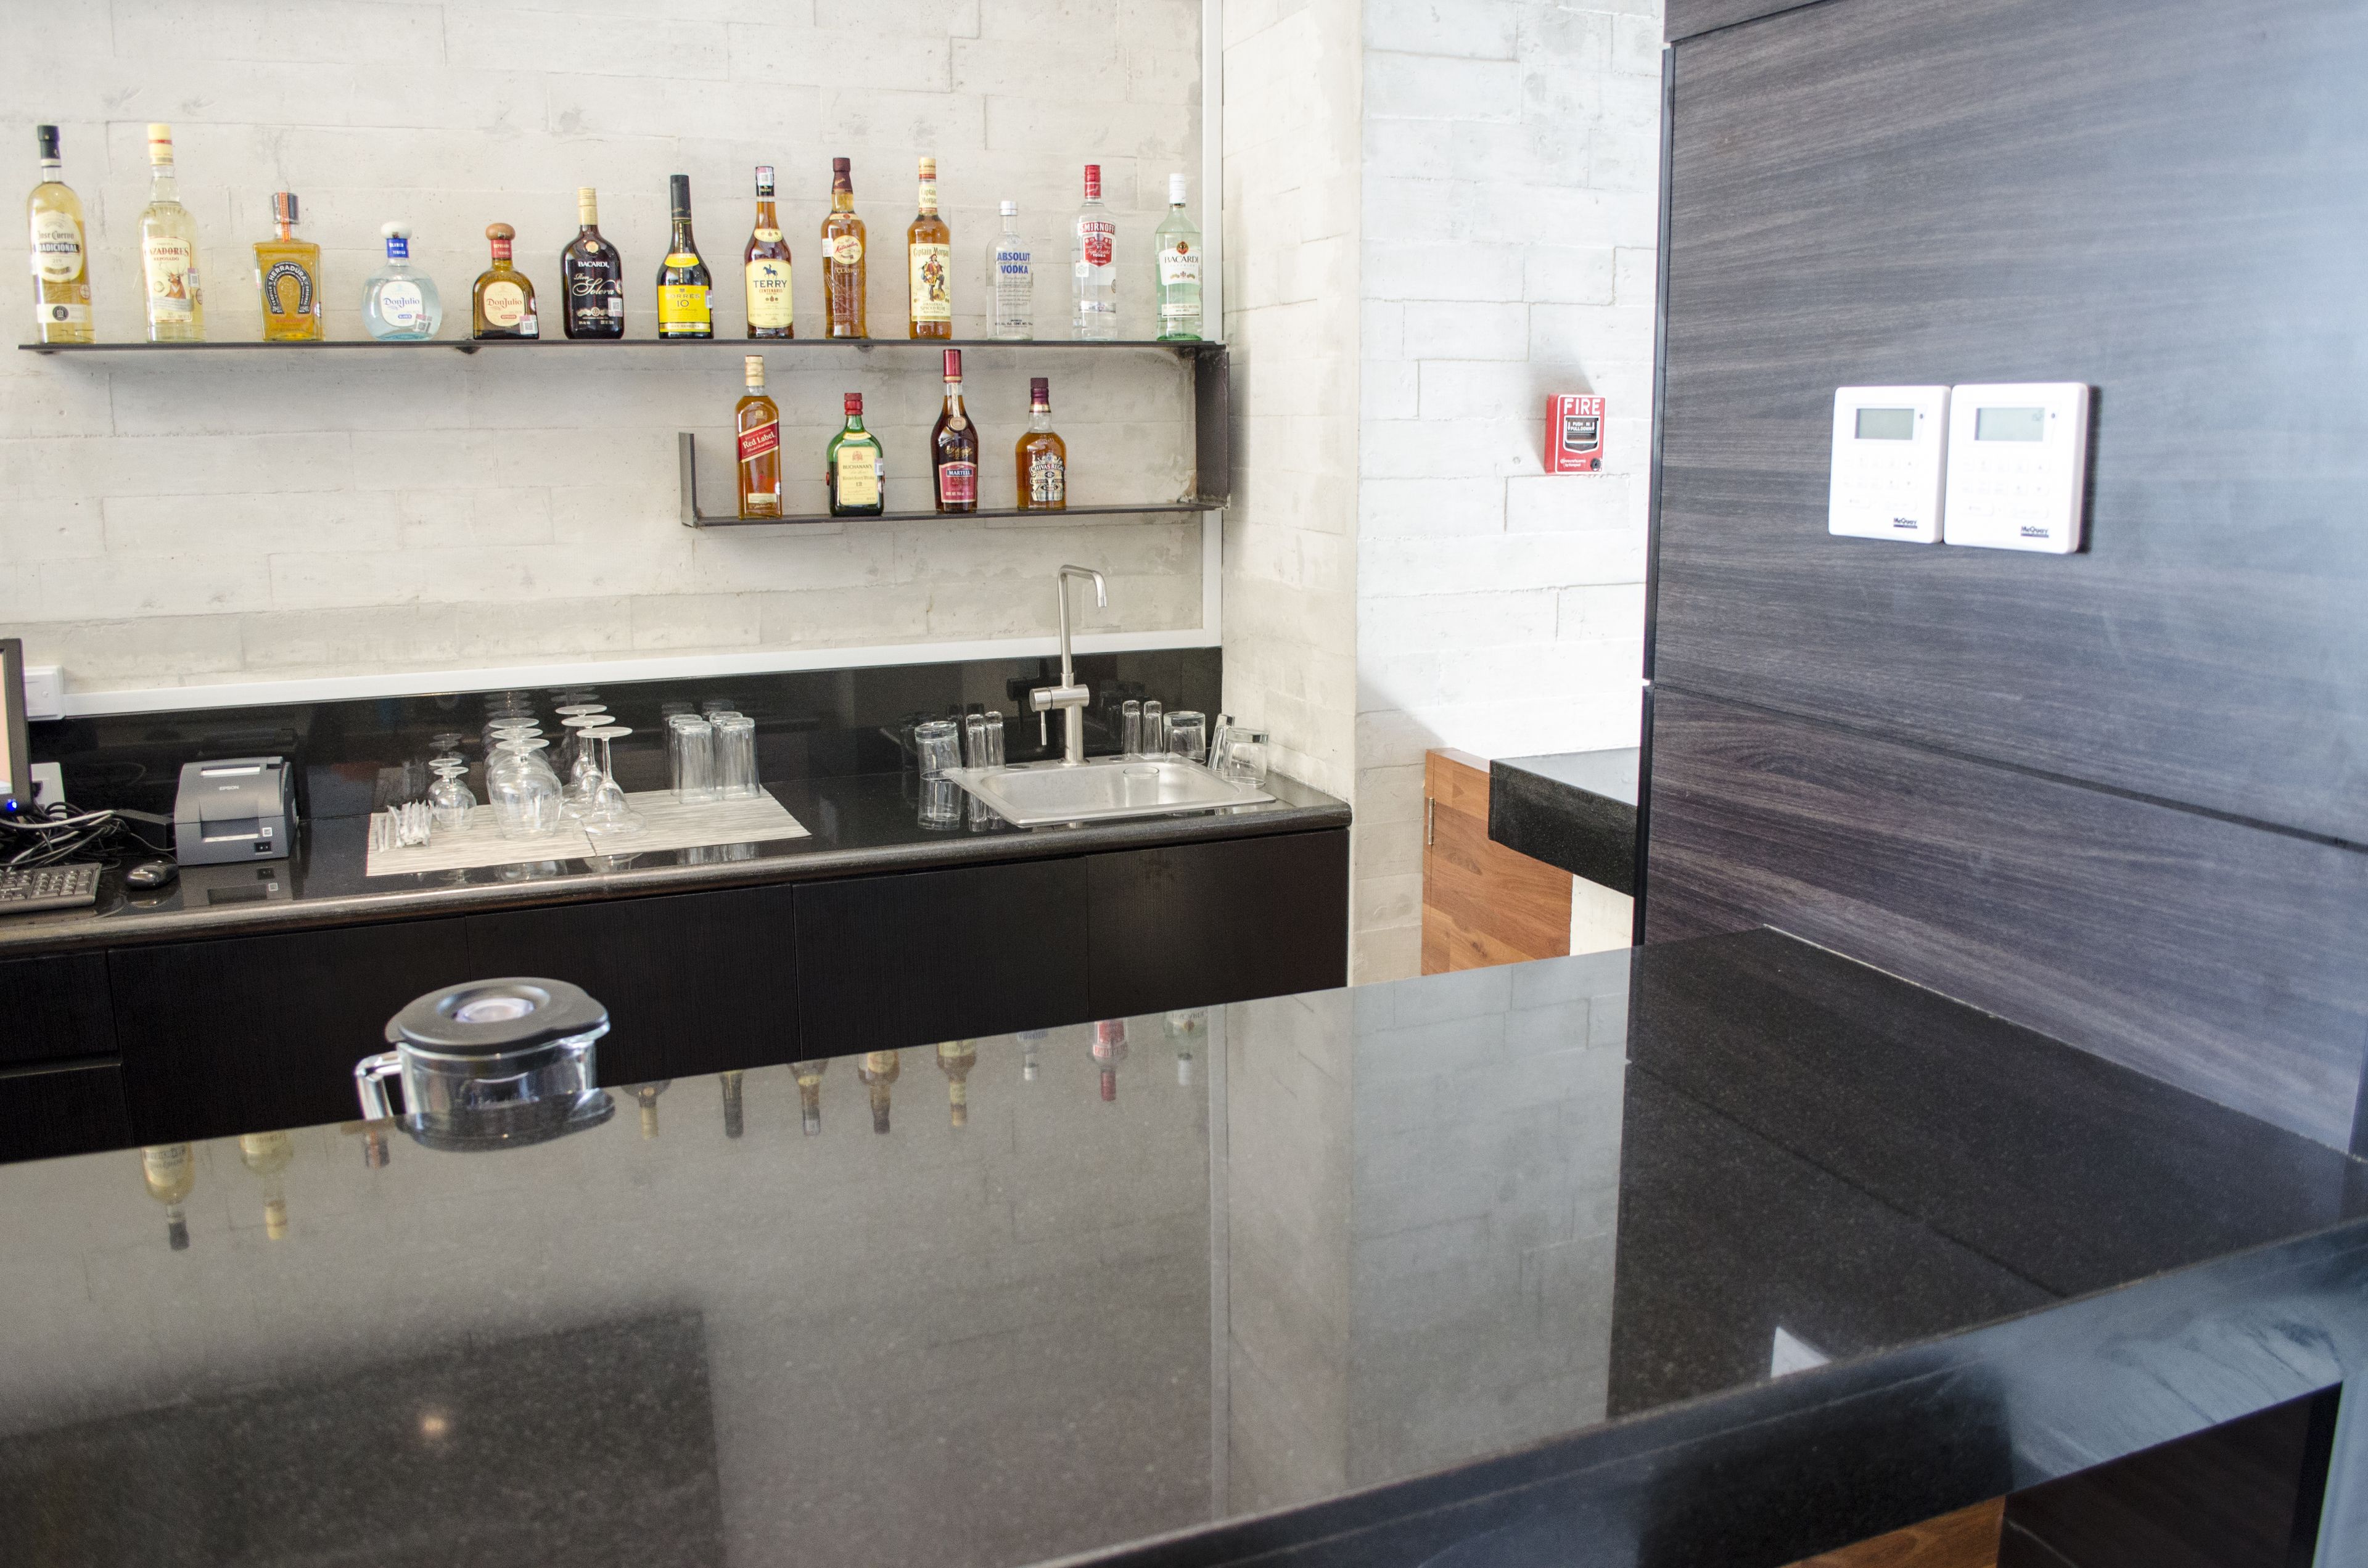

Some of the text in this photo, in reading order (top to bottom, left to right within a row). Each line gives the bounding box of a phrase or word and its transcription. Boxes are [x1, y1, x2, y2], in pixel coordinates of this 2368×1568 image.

[1080, 222, 1114, 233] SMIRNOFF
[36, 244, 77, 252] RADICIONAL
[145, 247, 189, 257] AZADORES
[913, 247, 948, 257] Captain Morgan
[997, 252, 1030, 261] ABSOLUT
[268, 265, 306, 281] HERRADURA
[1001, 265, 1029, 274] VODKA
[572, 278, 616, 296] Solera
[753, 280, 787, 288] TERRY
[677, 299, 689, 307] 10
[1564, 398, 1601, 415] FIRE
[742, 431, 775, 449] Red Label
[1030, 464, 1064, 472] CHIVAS REGAL
[2021, 525, 2048, 533] McQuay
